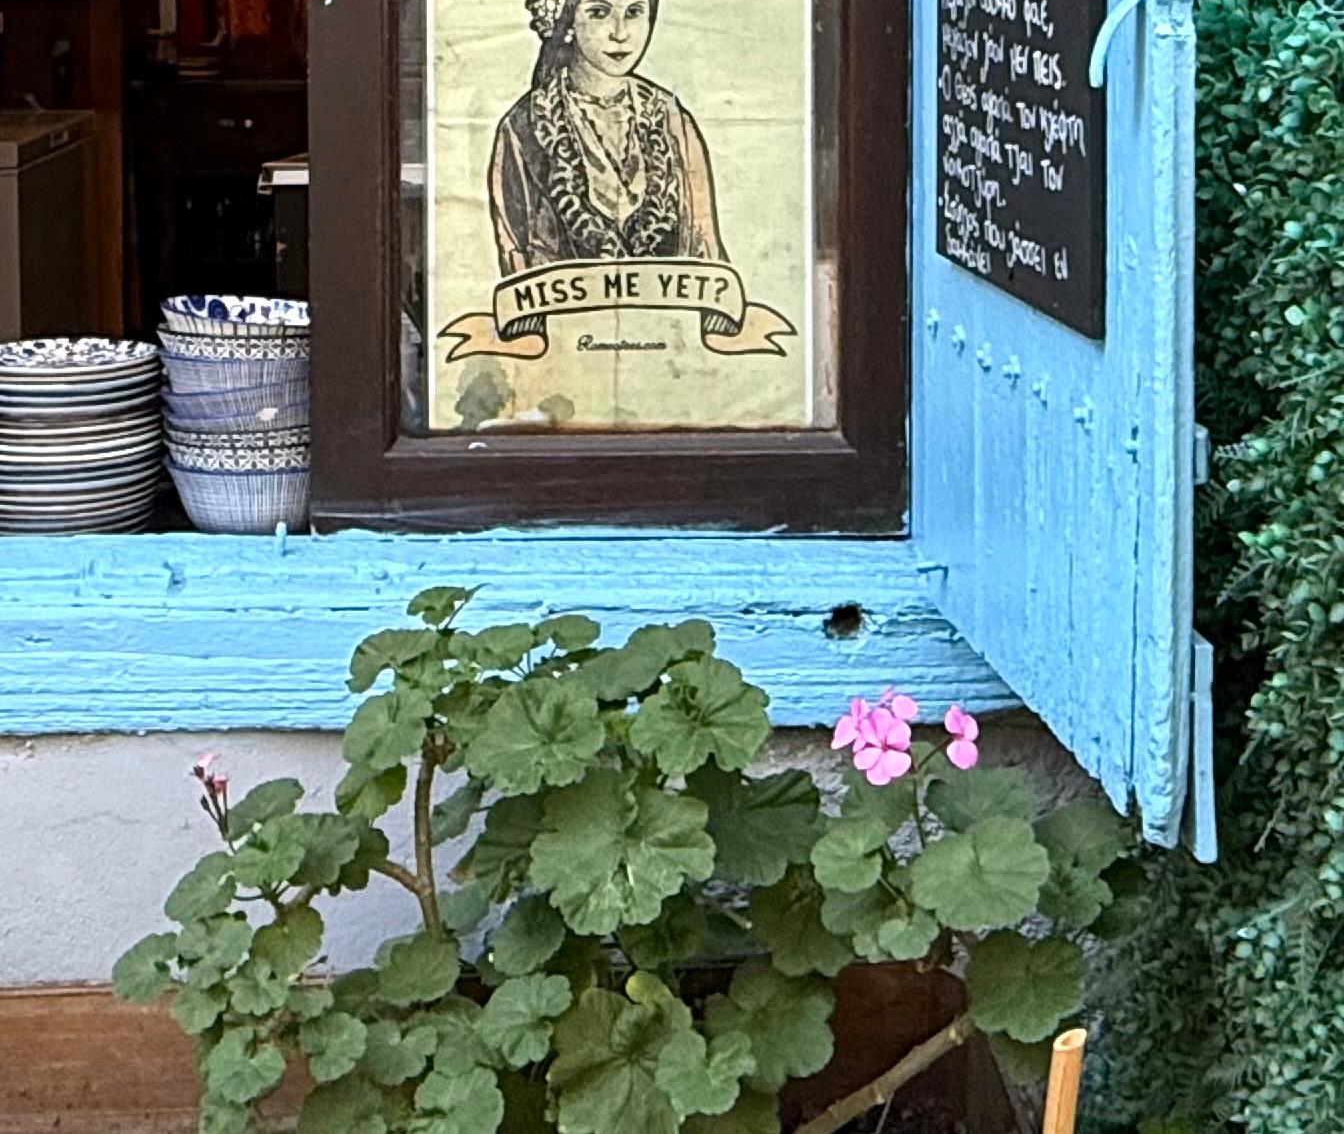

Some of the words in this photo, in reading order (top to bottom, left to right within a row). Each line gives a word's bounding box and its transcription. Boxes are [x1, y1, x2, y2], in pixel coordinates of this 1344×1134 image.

[1040, 159, 1064, 191] τον
[515, 276, 588, 312] MISS
[605, 272, 640, 298] ME
[658, 274, 729, 302] YET?
